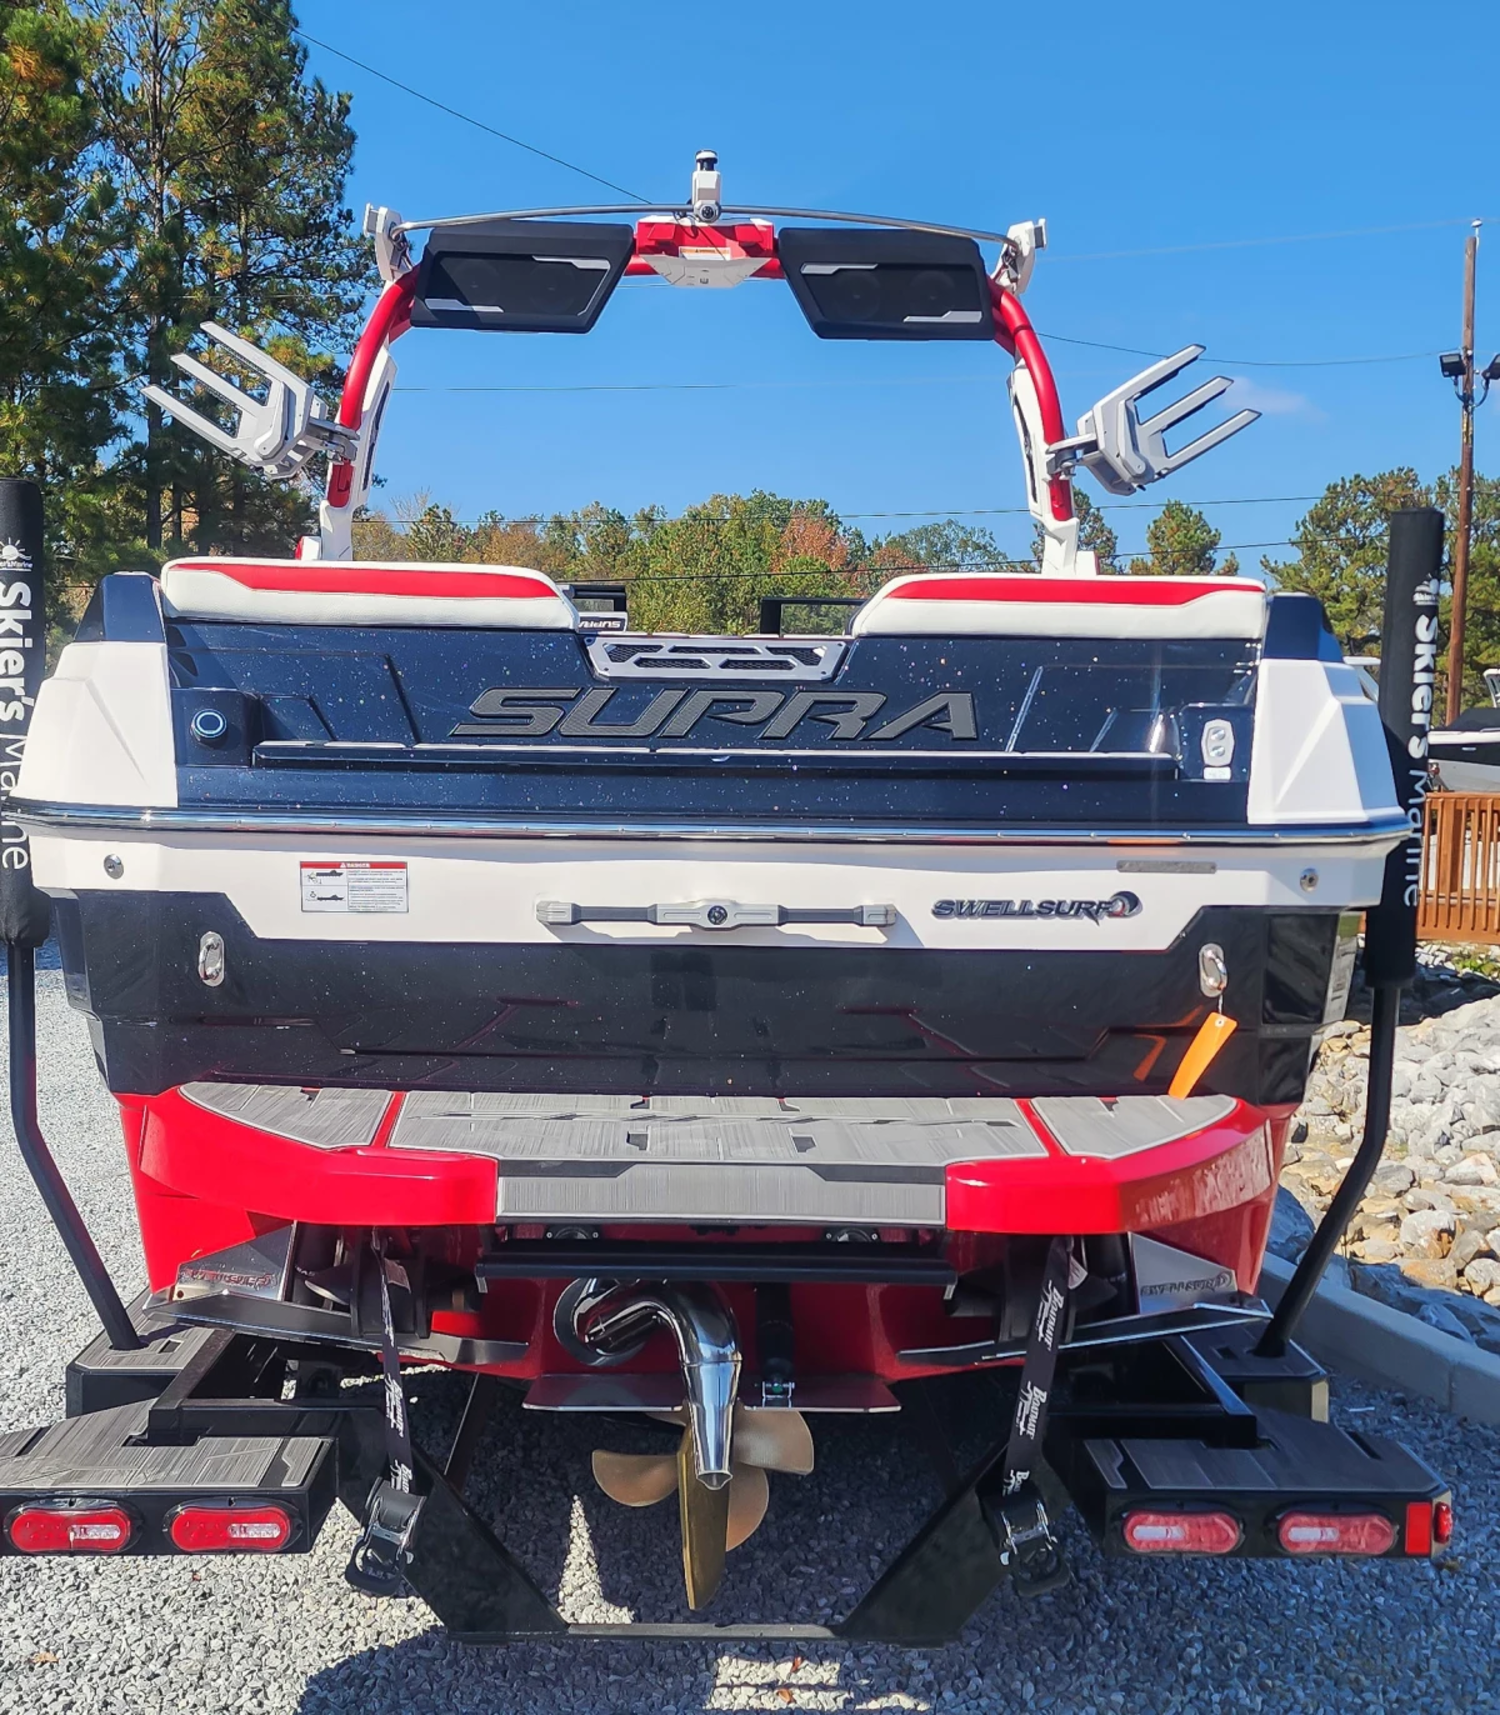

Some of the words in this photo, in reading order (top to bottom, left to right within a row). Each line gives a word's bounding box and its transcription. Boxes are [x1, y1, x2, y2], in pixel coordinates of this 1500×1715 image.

[0, 581, 34, 721] Skier's
[448, 686, 979, 741] SUPRA
[1408, 613, 1439, 760] Skiers
[0, 733, 30, 870] Mane
[931, 899, 1113, 927] SWELLSURF
